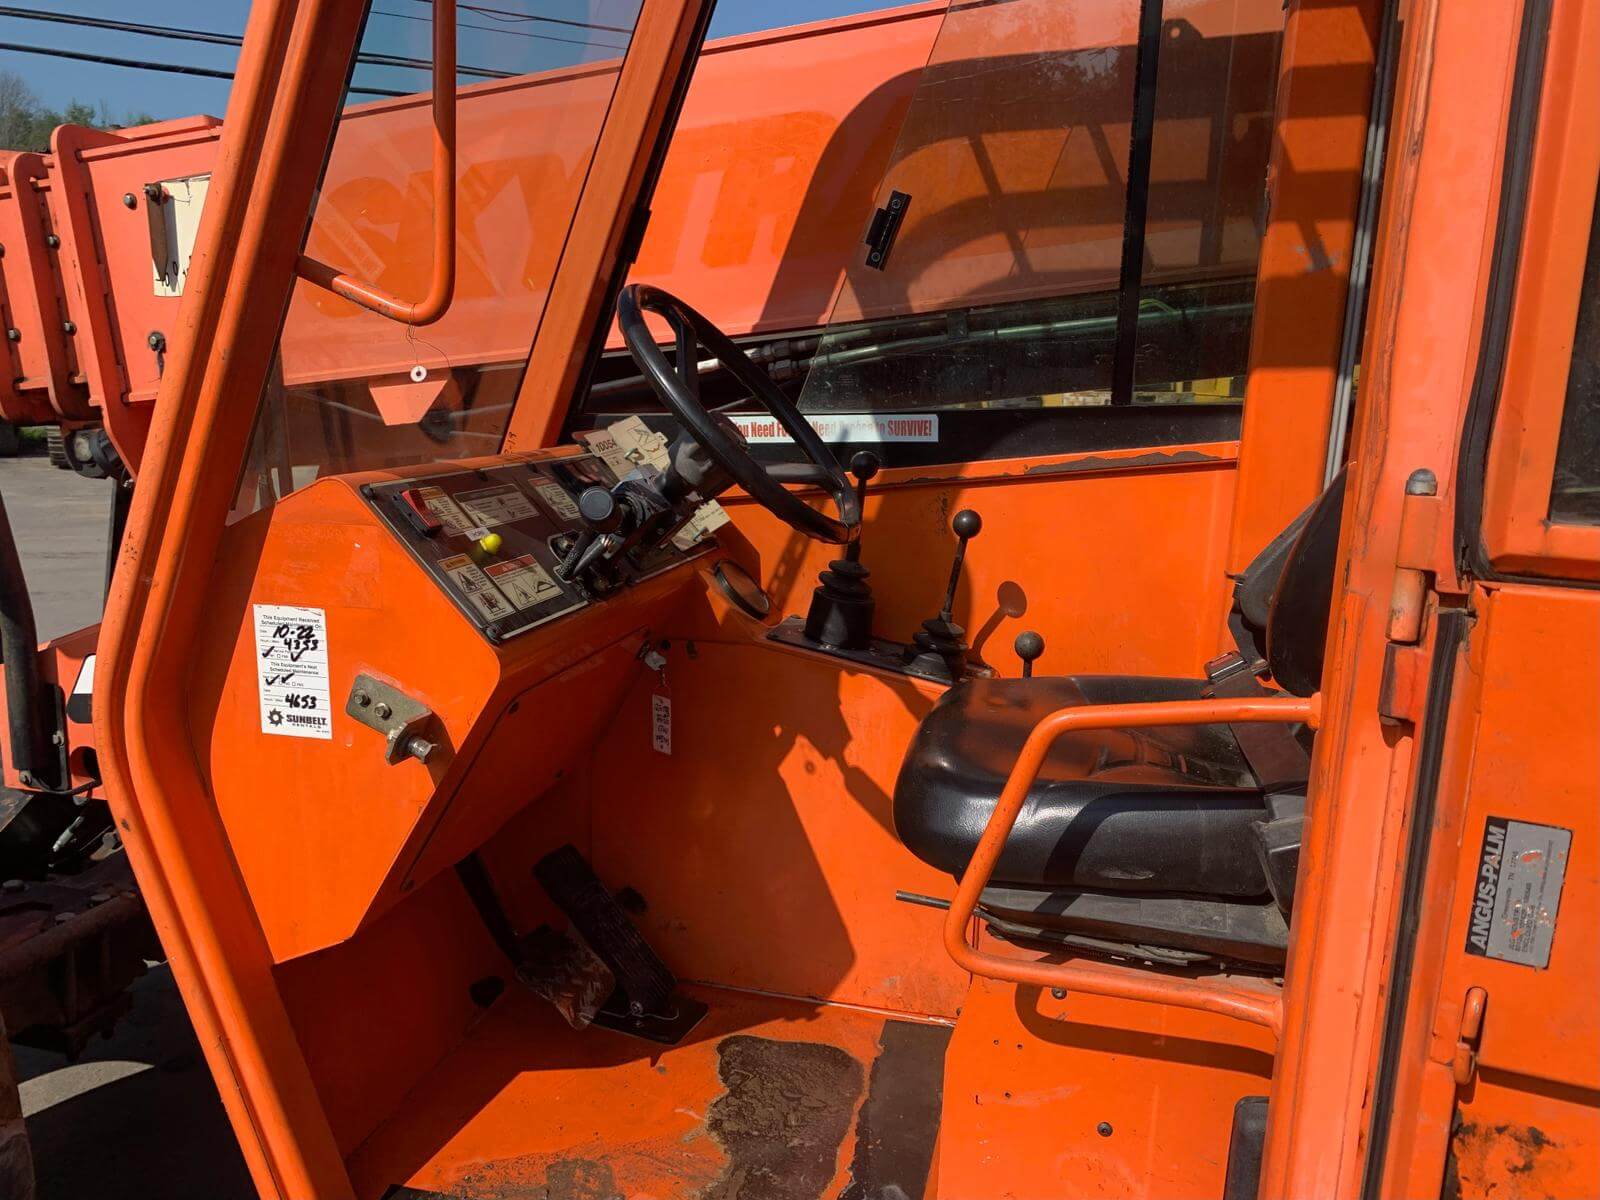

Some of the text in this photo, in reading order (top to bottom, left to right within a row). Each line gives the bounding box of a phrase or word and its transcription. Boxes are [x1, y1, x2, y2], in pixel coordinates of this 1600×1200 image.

[736, 424, 749, 438] ou
[751, 421, 775, 437] Need
[887, 419, 932, 437] SURVIVE!
[283, 638, 319, 651] 4353
[285, 693, 317, 709] 4653
[286, 714, 327, 725] SUNBELT
[1470, 825, 1507, 950] ANGUS-PALM
